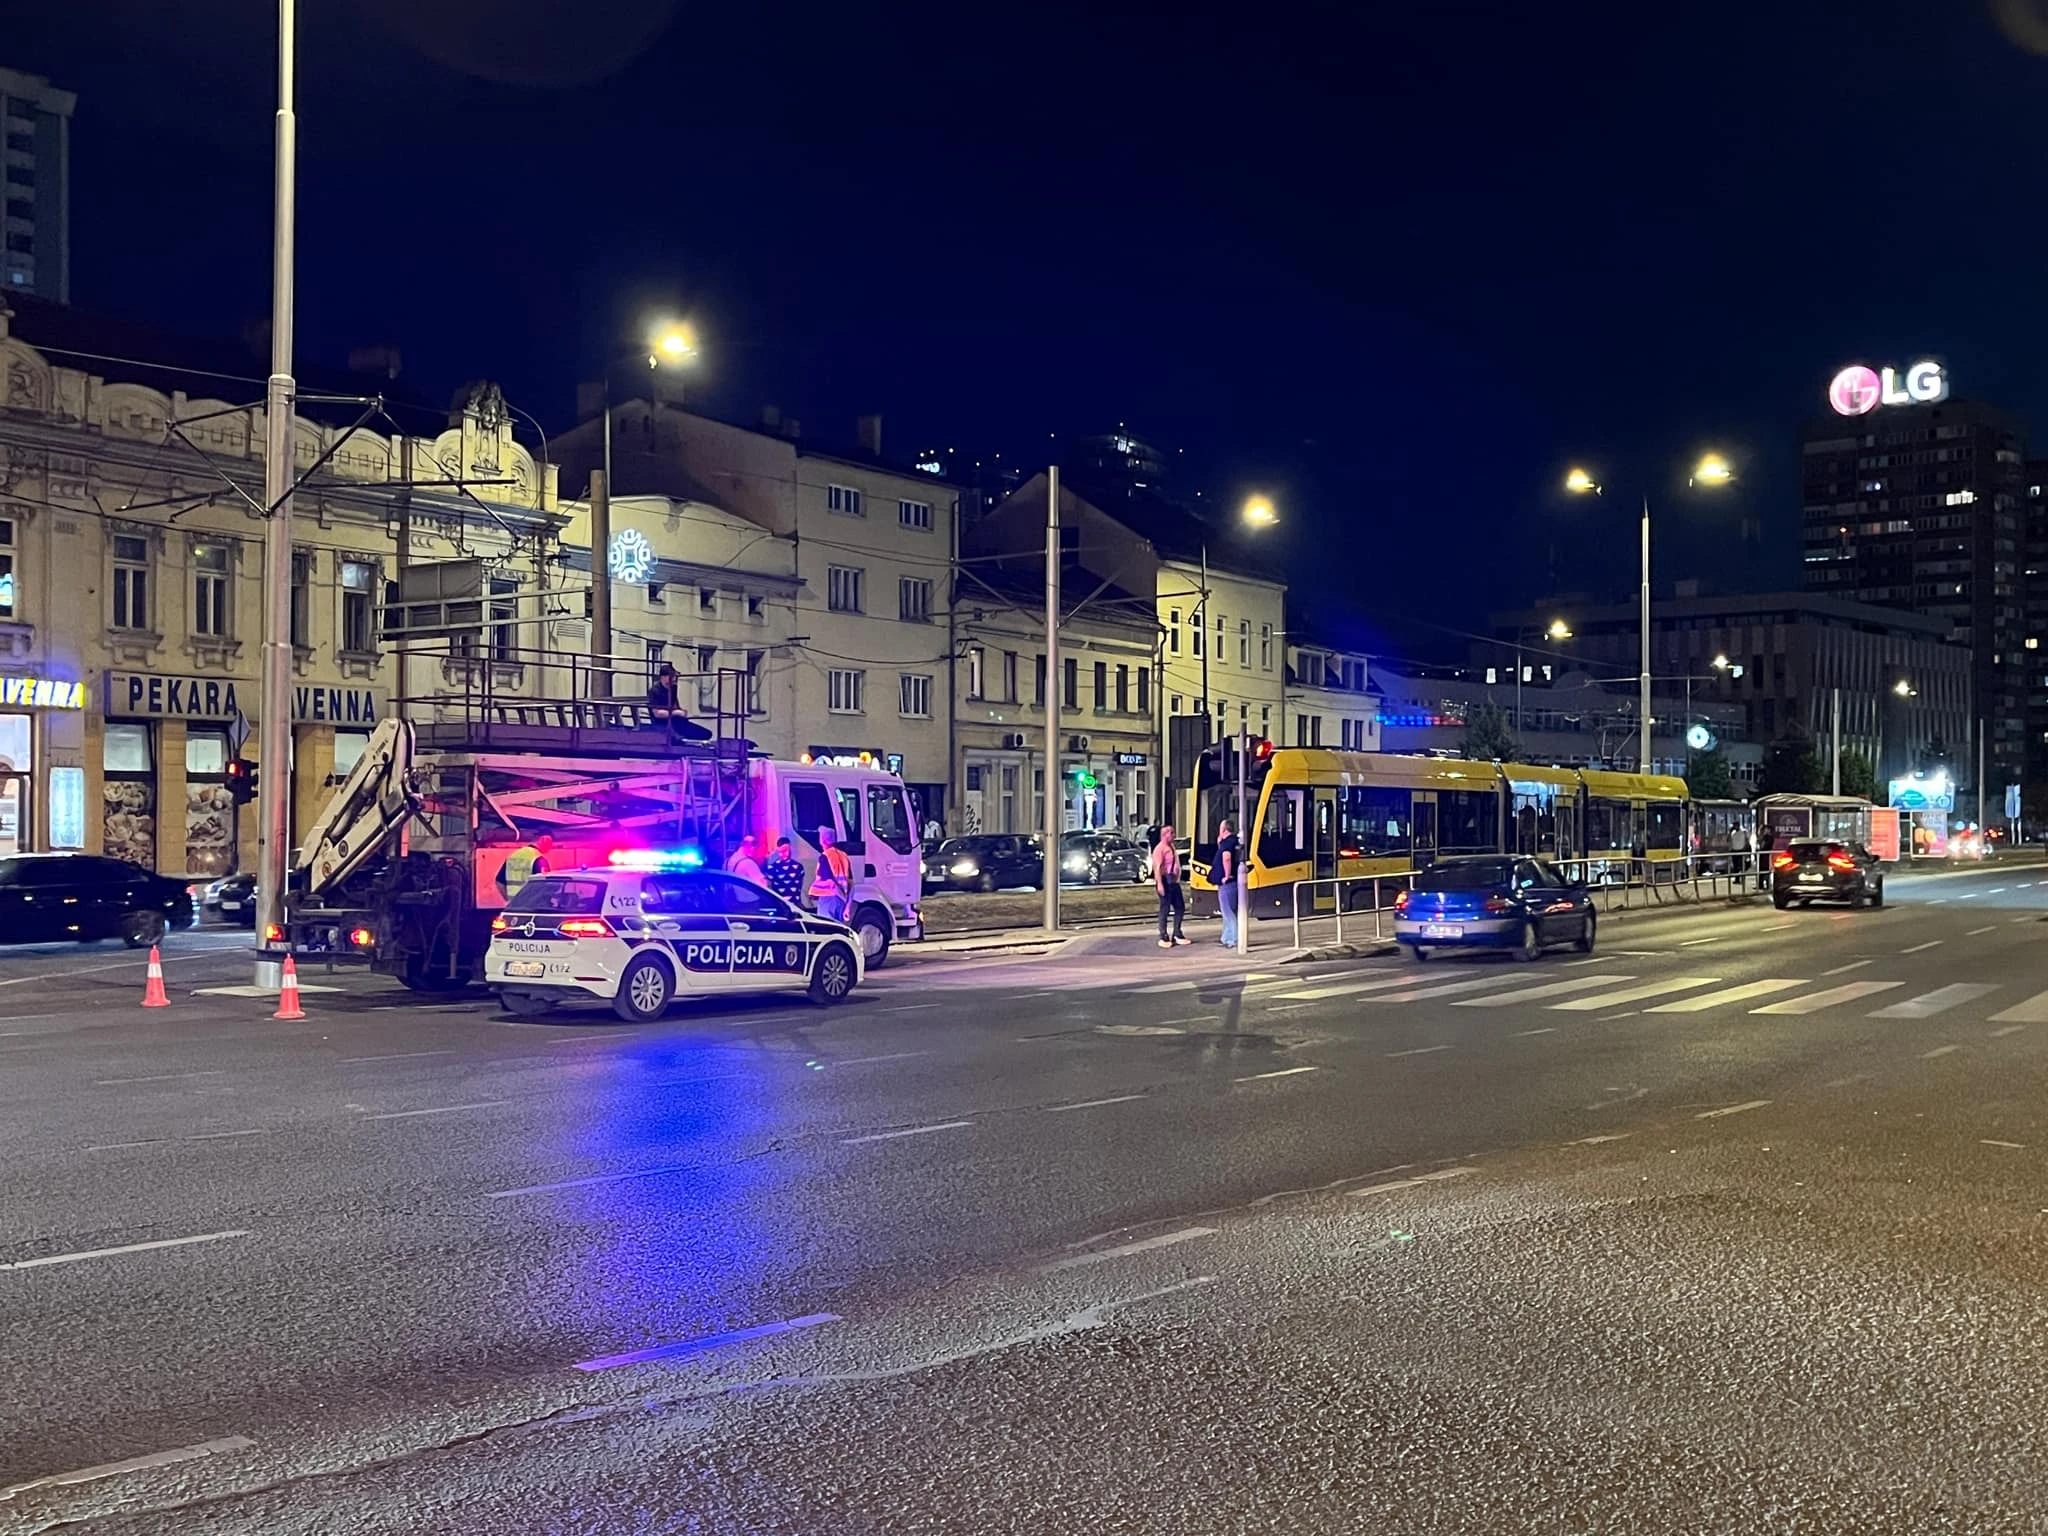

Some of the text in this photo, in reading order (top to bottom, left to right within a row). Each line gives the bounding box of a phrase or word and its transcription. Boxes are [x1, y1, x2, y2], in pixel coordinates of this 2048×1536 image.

[1881, 361, 1944, 405] LG
[128, 676, 375, 722] PEKARA VENNA
[509, 942, 551, 953] POLICIJA
[686, 944, 775, 964] POLICIJA
